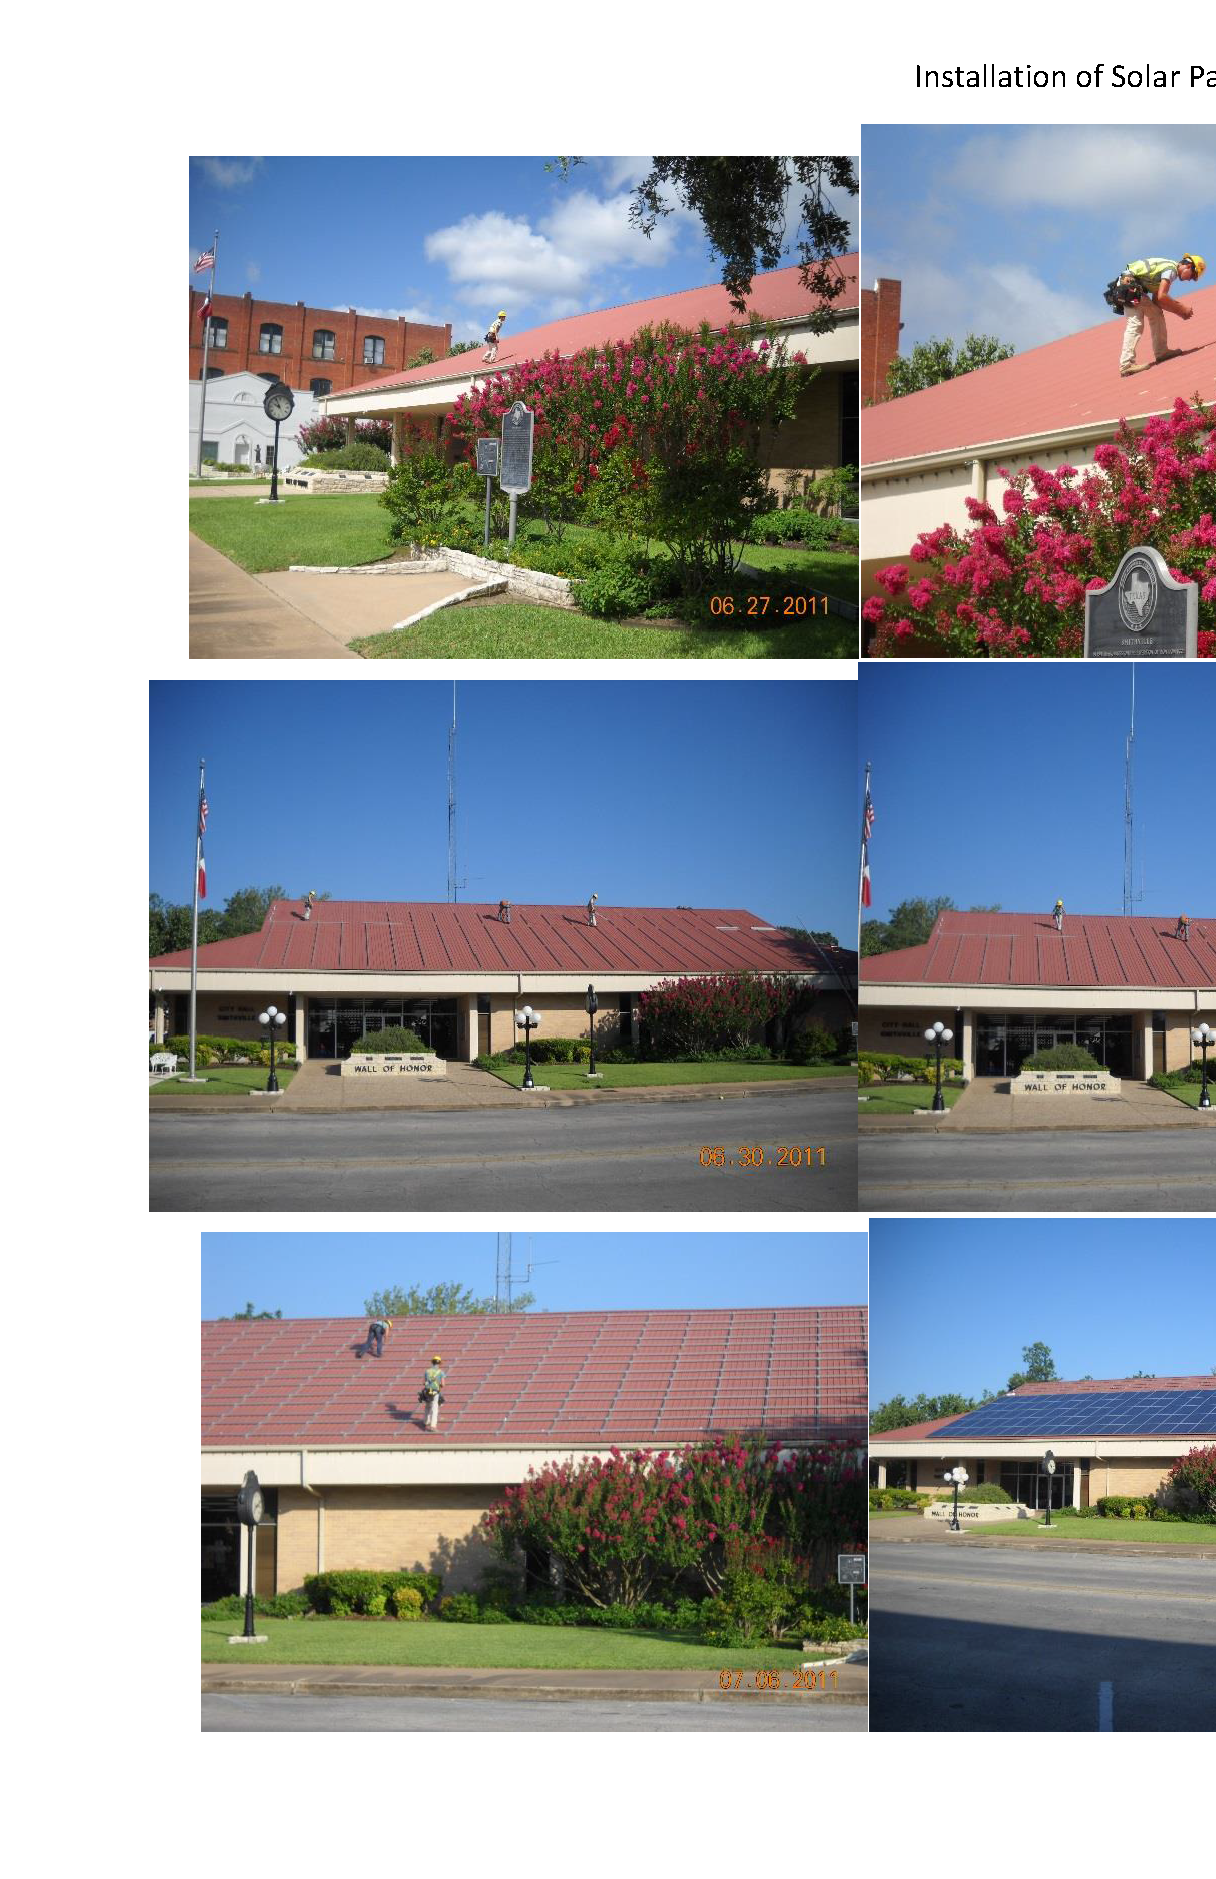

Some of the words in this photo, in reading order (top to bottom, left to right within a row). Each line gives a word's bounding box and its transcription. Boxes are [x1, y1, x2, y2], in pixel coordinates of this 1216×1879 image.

[354, 1065, 377, 1073] WALL
[383, 1064, 395, 1072] OF
[400, 1064, 433, 1072] HONOR
[1024, 1083, 1047, 1091] WALL
[1054, 1083, 1067, 1091] OF
[1072, 1083, 1106, 1091] HONOR
